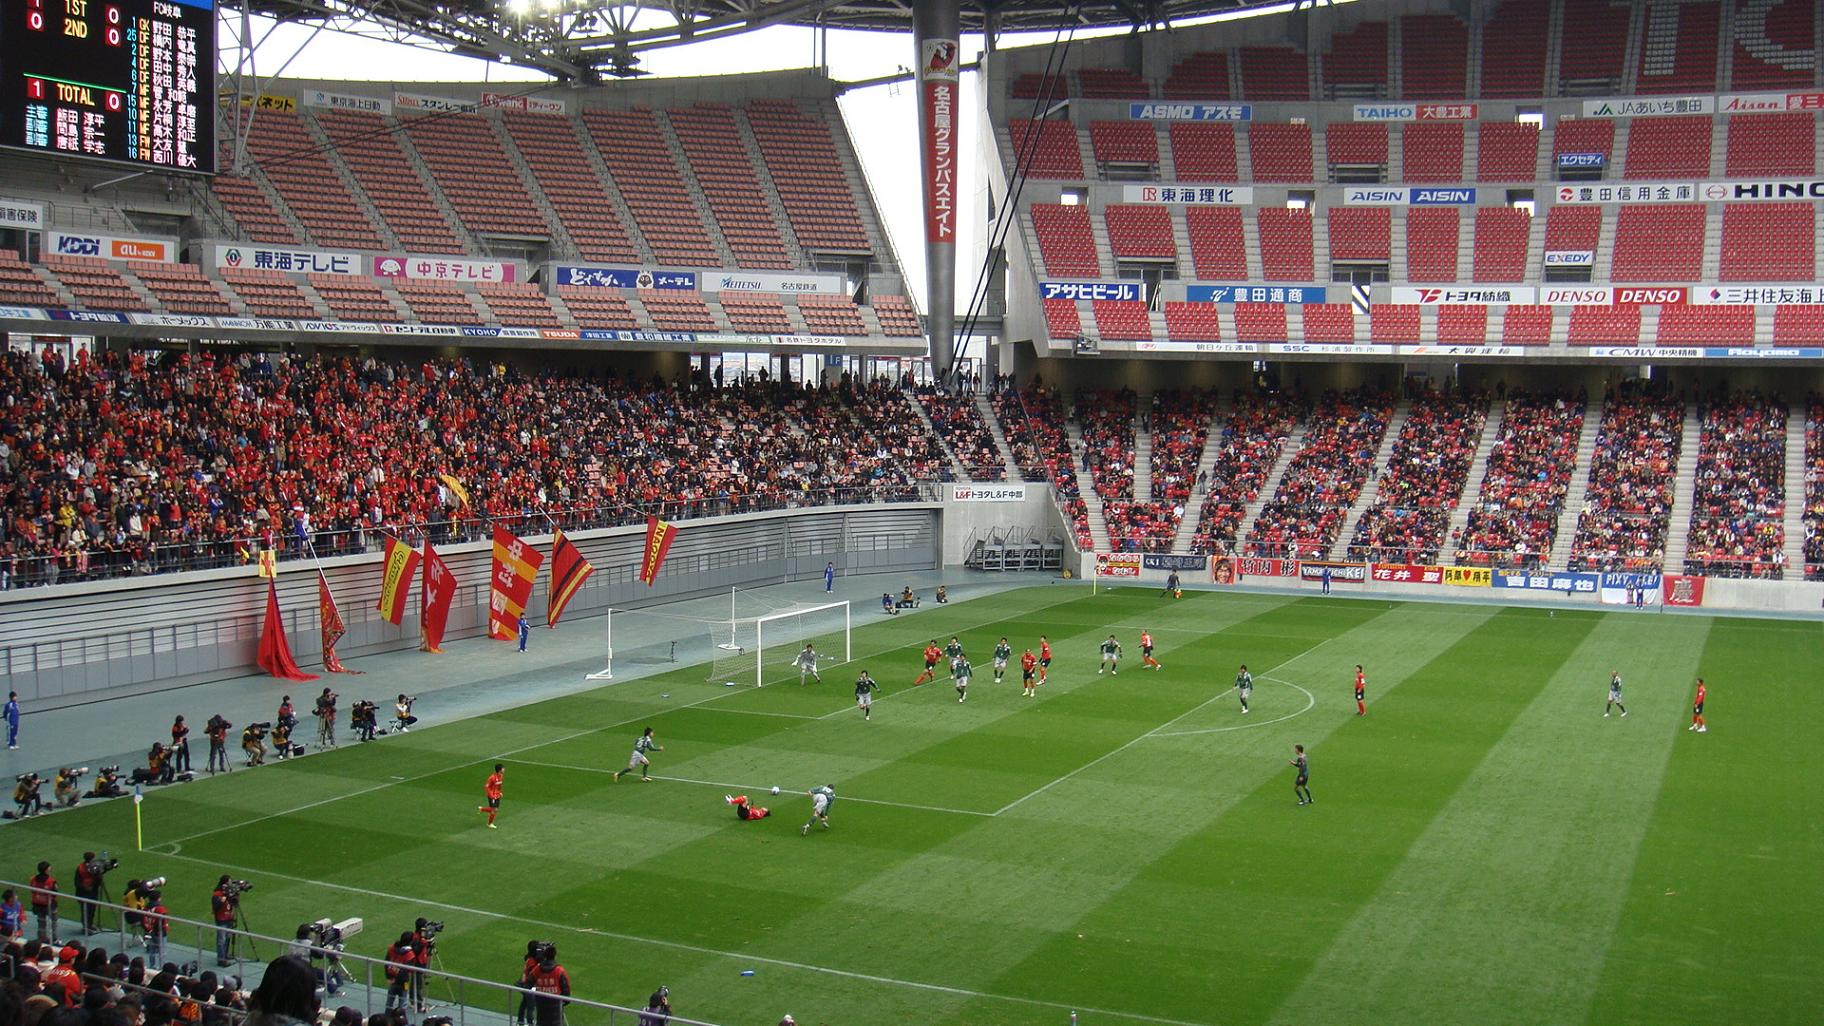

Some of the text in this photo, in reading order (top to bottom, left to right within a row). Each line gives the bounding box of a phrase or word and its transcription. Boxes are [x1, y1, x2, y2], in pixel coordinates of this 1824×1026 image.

[108, 7, 119, 24] 0
[31, 12, 120, 45] 0 2ND 0
[126, 28, 137, 41] 25
[139, 31, 150, 44] DF
[131, 43, 137, 56] 2
[139, 44, 150, 57] DF
[131, 56, 137, 68] 4
[139, 58, 150, 70] DF
[153, 61, 172, 75] 田中
[131, 69, 137, 82] 6
[139, 70, 150, 83] DF
[153, 73, 172, 88] 秋田
[33, 80, 120, 110] 1 TOTAL 0
[131, 82, 137, 94] 7
[127, 94, 137, 107] 15
[1618, 100, 1702, 115] JAあいち豊田
[128, 107, 137, 120] 10
[1140, 105, 1243, 119] ASMO アスモ
[1357, 107, 1412, 118] TAIHO
[128, 121, 136, 133] 11
[128, 134, 137, 147] 13
[153, 137, 173, 151] 大友
[128, 147, 137, 159] 16
[153, 150, 173, 165] 西川
[933, 85, 951, 238] 名古屋グランパスエイト
[1560, 155, 1602, 166] エクセディ
[1161, 188, 1234, 202] 東海理化
[1352, 191, 1402, 201] AISIN
[1416, 191, 1470, 202] AISIN
[1579, 185, 1691, 201] 豊田信用金庫
[58, 235, 100, 256] KDDI
[254, 250, 349, 273] 東海テレビ
[1546, 253, 1590, 263] EXEDY
[417, 261, 494, 280] 中京テレビ
[1045, 283, 1133, 300] アサヒビール
[1234, 287, 1303, 302] 豊田通商
[1547, 290, 1607, 302] DENSO
[1620, 290, 1681, 303] DENSO
[1242, 558, 1272, 575] 竹内
[1345, 566, 1365, 580] KEI
[1374, 568, 1412, 581] 花井
